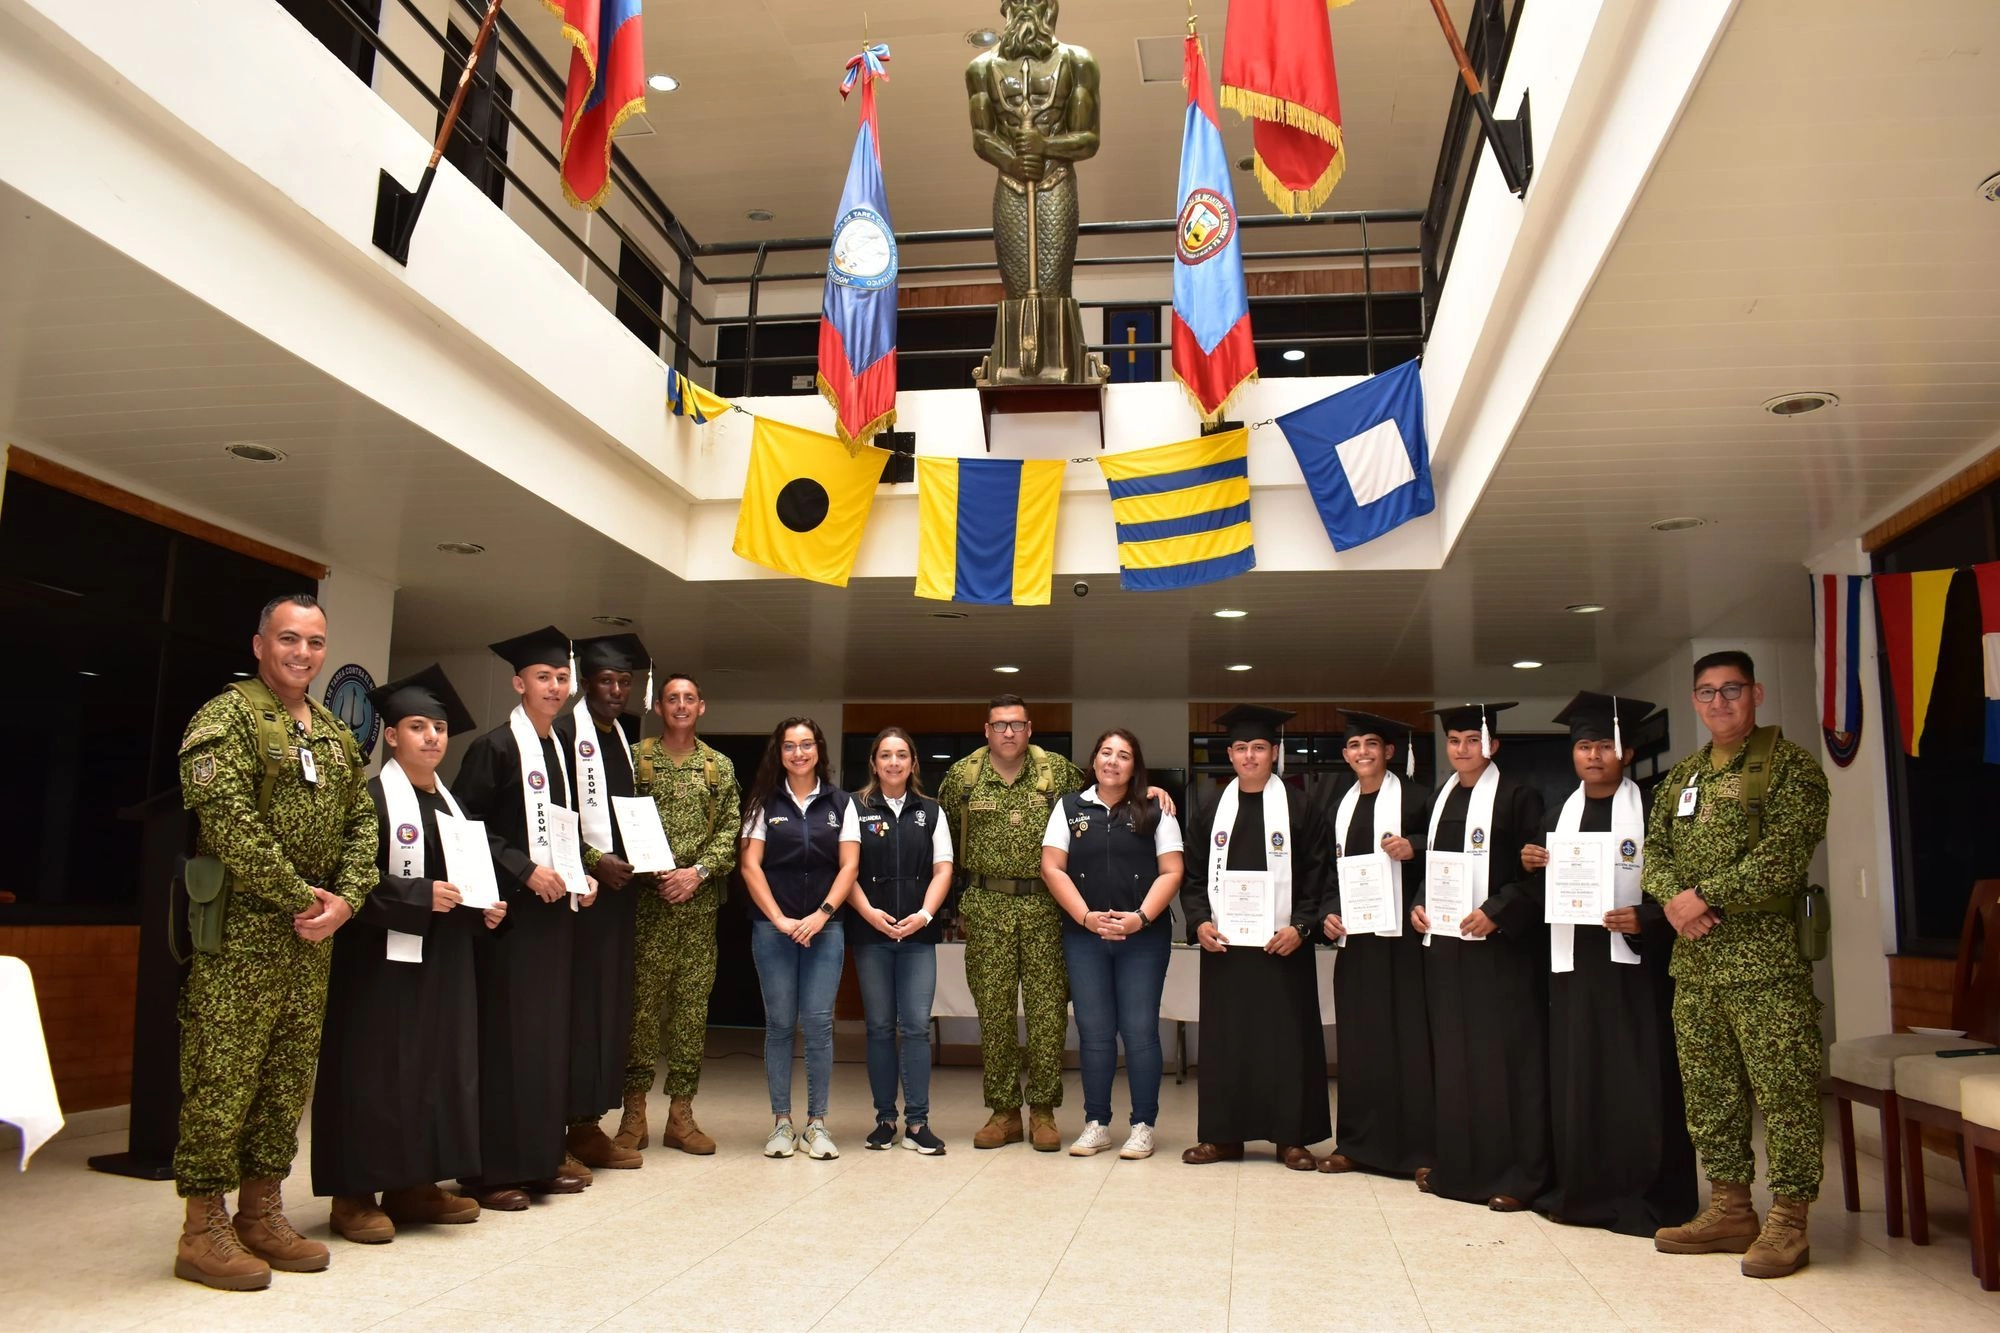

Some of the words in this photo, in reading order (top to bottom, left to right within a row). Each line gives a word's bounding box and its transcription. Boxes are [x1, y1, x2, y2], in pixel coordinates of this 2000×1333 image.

[853, 211, 875, 220] TAREA
[345, 667, 365, 679] CONTRA
[587, 767, 596, 795] PROM
[537, 803, 546, 832] PROM
[1068, 815, 1091, 825] CLAUDIA
